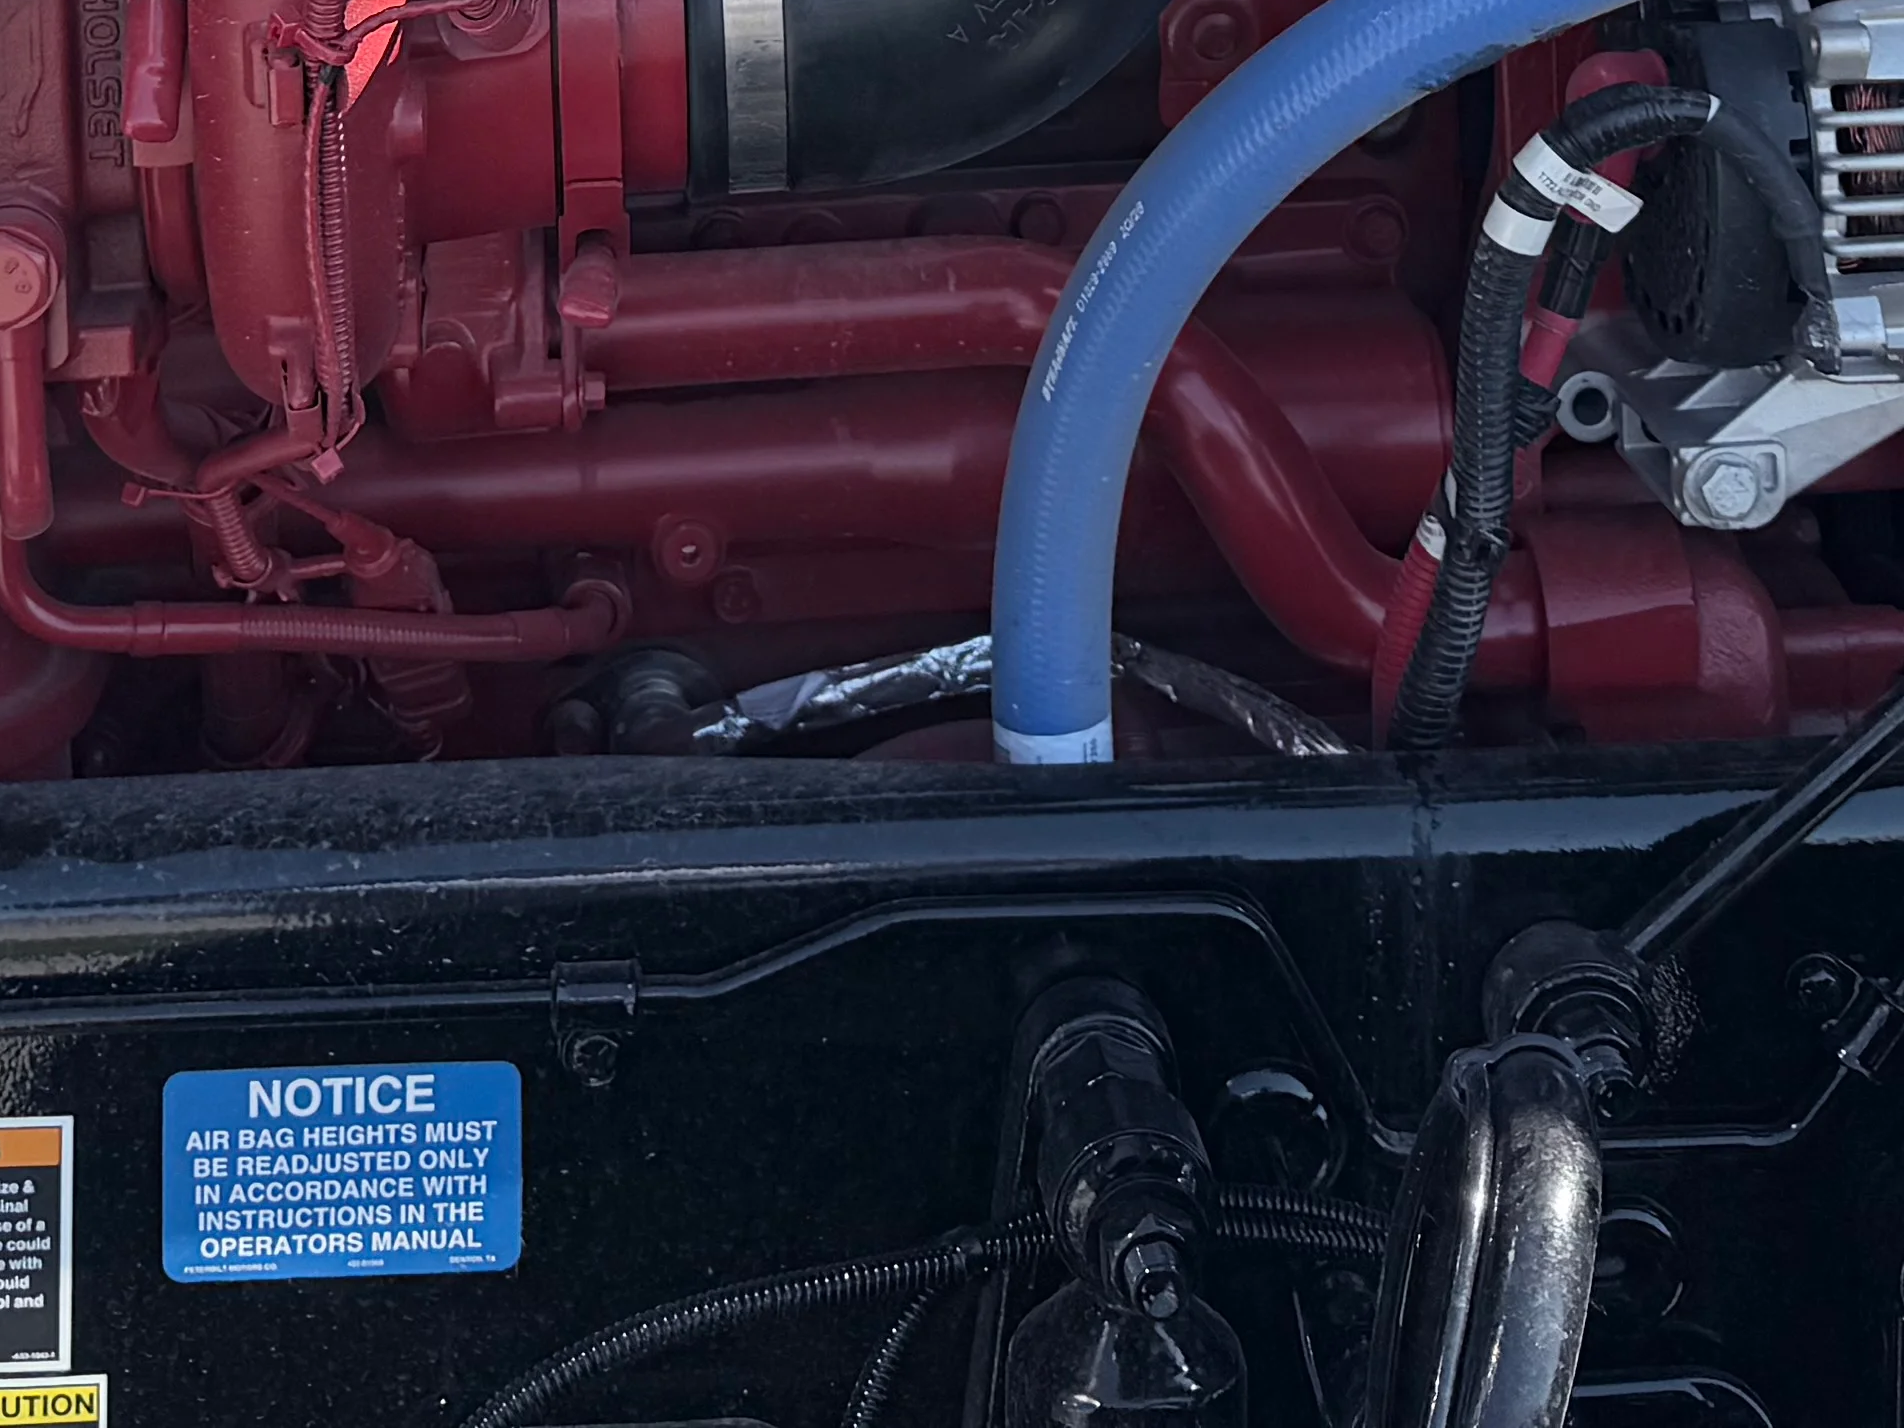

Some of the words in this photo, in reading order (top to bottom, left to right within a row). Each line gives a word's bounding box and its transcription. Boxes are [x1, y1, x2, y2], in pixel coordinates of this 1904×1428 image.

[250, 1073, 435, 1119] NOTICE
[186, 1130, 230, 1152] AIR
[238, 1128, 294, 1150] BAG
[303, 1123, 417, 1148] HEIGHTS
[425, 1120, 497, 1144] MUST
[194, 1157, 228, 1178] BE
[236, 1150, 411, 1176] READJUSTED
[418, 1147, 489, 1170] ONLY
[23, 1179, 34, 1197] &
[195, 1183, 220, 1206] IN
[228, 1177, 414, 1205] ACCORDANCE
[422, 1174, 486, 1198] WITH
[15, 1219, 32, 1236] of
[35, 1218, 46, 1235] a
[198, 1204, 392, 1232] INSTRUCTIONS
[399, 1203, 424, 1225] IN
[432, 1201, 484, 1227] THE
[6, 1236, 51, 1252] could
[200, 1232, 363, 1260] OPERATORS
[372, 1228, 482, 1254] MANUAL
[8, 1257, 42, 1275] with
[14, 1293, 44, 1309] and
